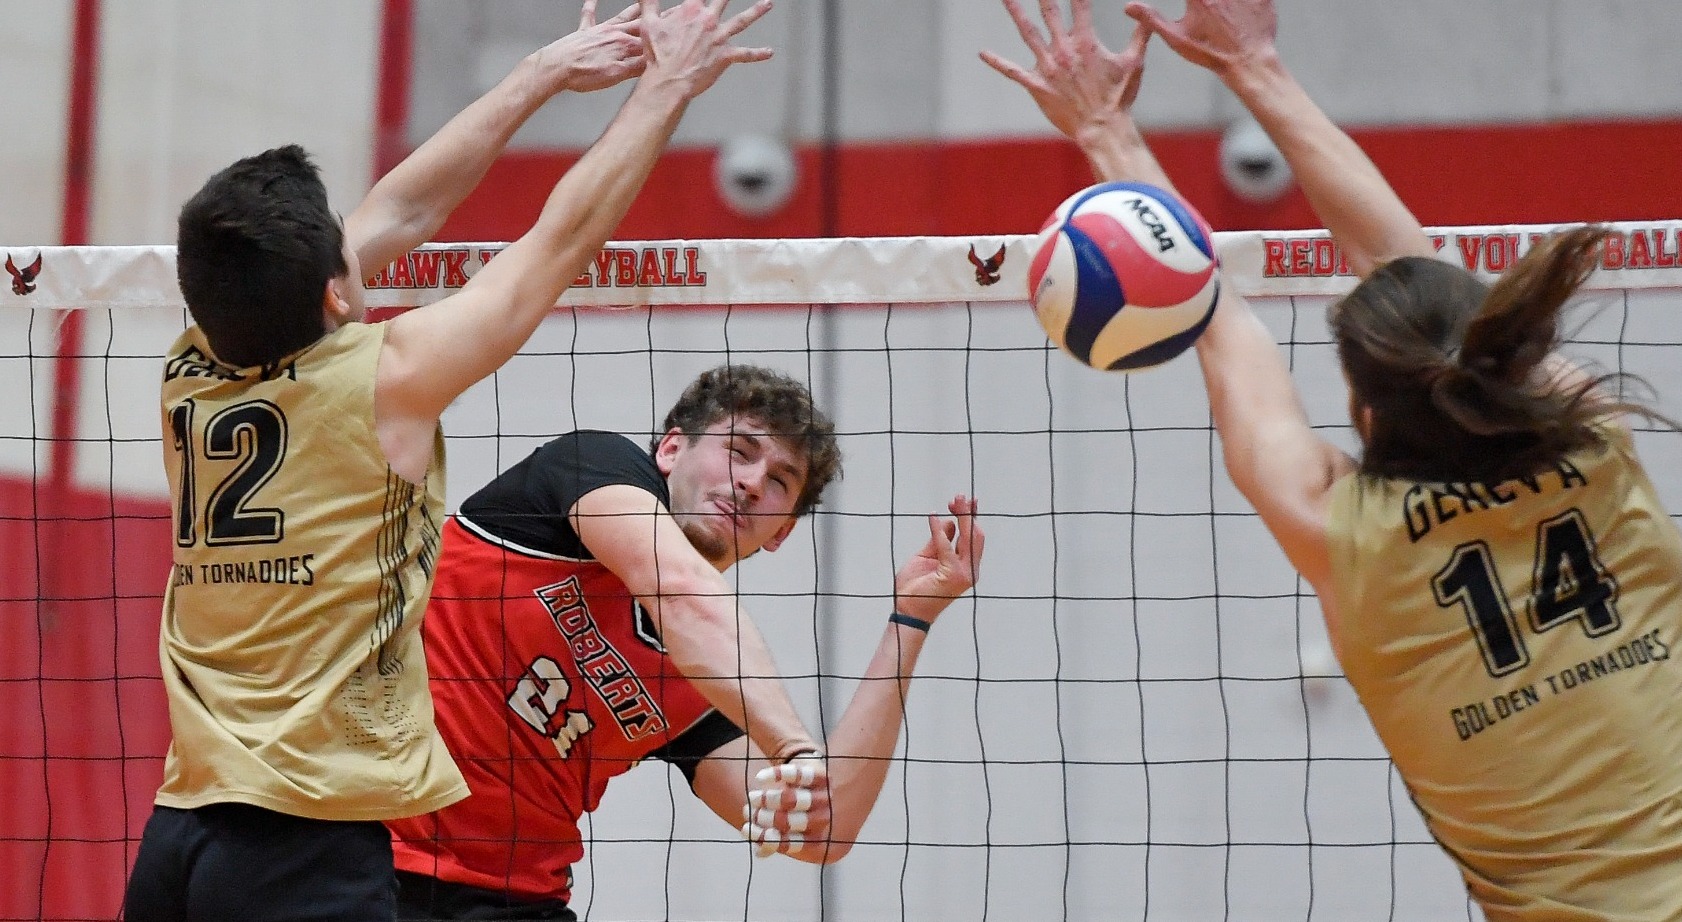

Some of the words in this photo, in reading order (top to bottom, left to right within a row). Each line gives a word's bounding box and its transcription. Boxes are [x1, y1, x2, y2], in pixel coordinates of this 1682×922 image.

[1123, 198, 1175, 252] NCAA
[169, 397, 288, 548] 12
[200, 553, 315, 587] TORNADOES
[1430, 506, 1623, 679] 14
[532, 574, 671, 743] ROBERTS
[1450, 684, 1541, 742] GOLDEN
[1543, 627, 1671, 696] TORNADOES
